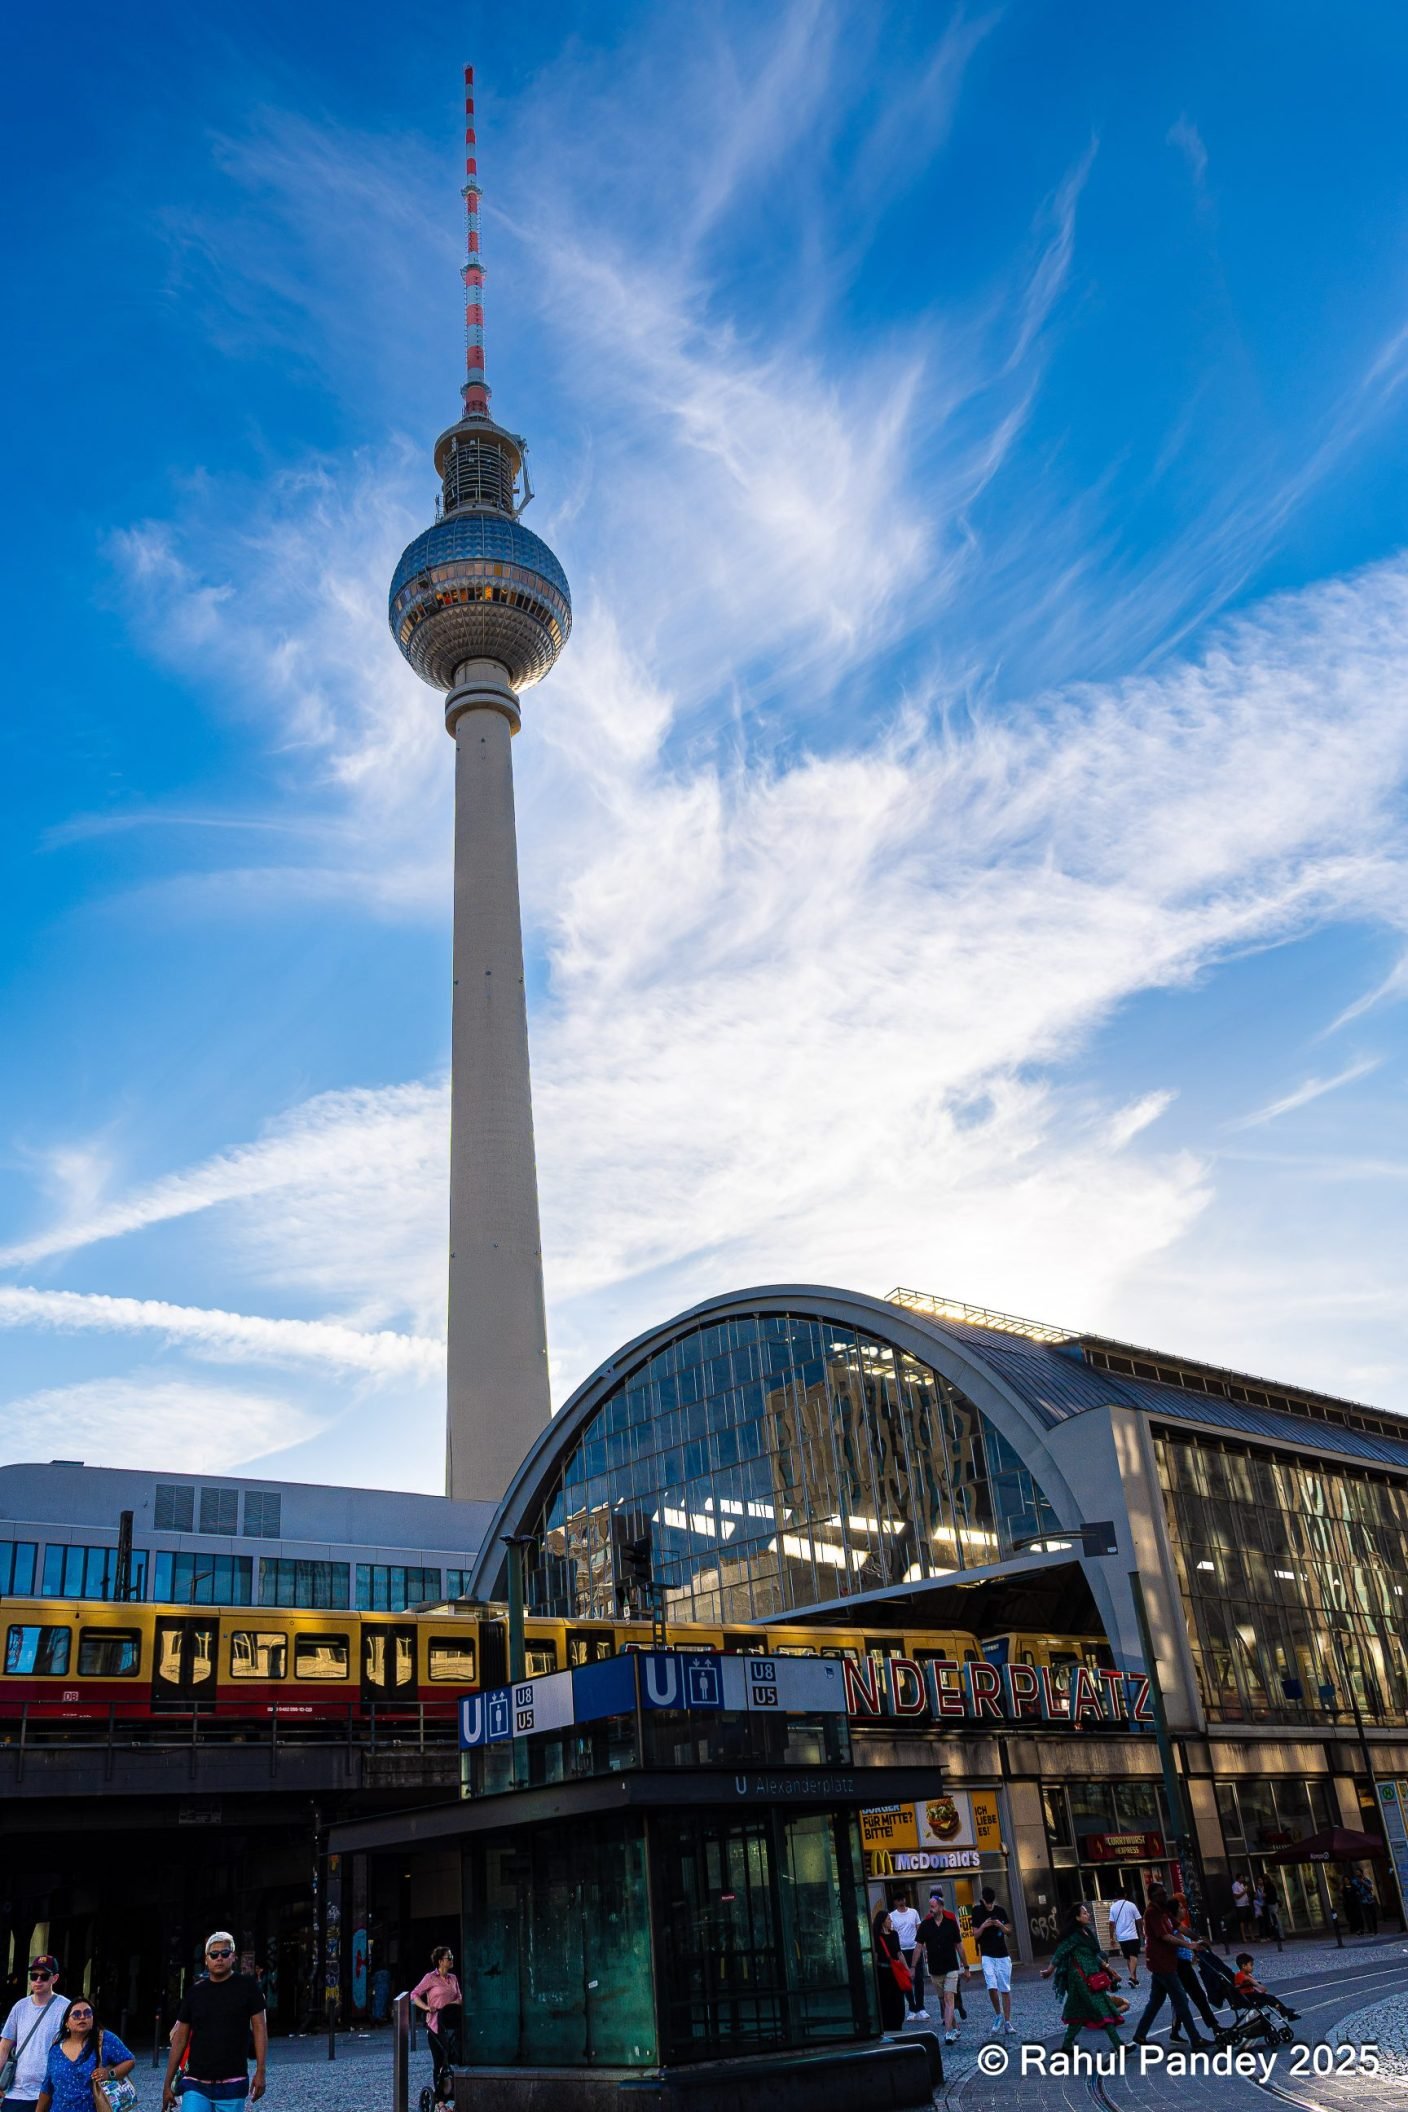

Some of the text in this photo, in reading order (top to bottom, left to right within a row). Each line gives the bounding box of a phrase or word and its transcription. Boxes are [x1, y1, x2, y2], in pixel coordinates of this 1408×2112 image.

[753, 1663, 774, 1680] U8
[646, 1657, 677, 1706] U
[842, 1656, 1155, 1722] NDERPLATZ
[64, 1692, 78, 1701] DB
[517, 1687, 532, 1705] U8
[755, 1688, 776, 1704] U5
[463, 1698, 482, 1743] U
[518, 1711, 533, 1729] U5
[735, 1775, 855, 1797] U Alexanderplatz
[974, 1805, 987, 1816] ICH
[863, 1811, 913, 1828] FÜR MITTE?
[976, 1814, 998, 1826] LIEBE
[865, 1826, 893, 1840] BITTE!
[978, 1826, 991, 1836] ES!
[1107, 1835, 1146, 1846] CURRYWURST
[1116, 1846, 1140, 1855] EXPRESS
[896, 1850, 980, 1871] McDonald's
